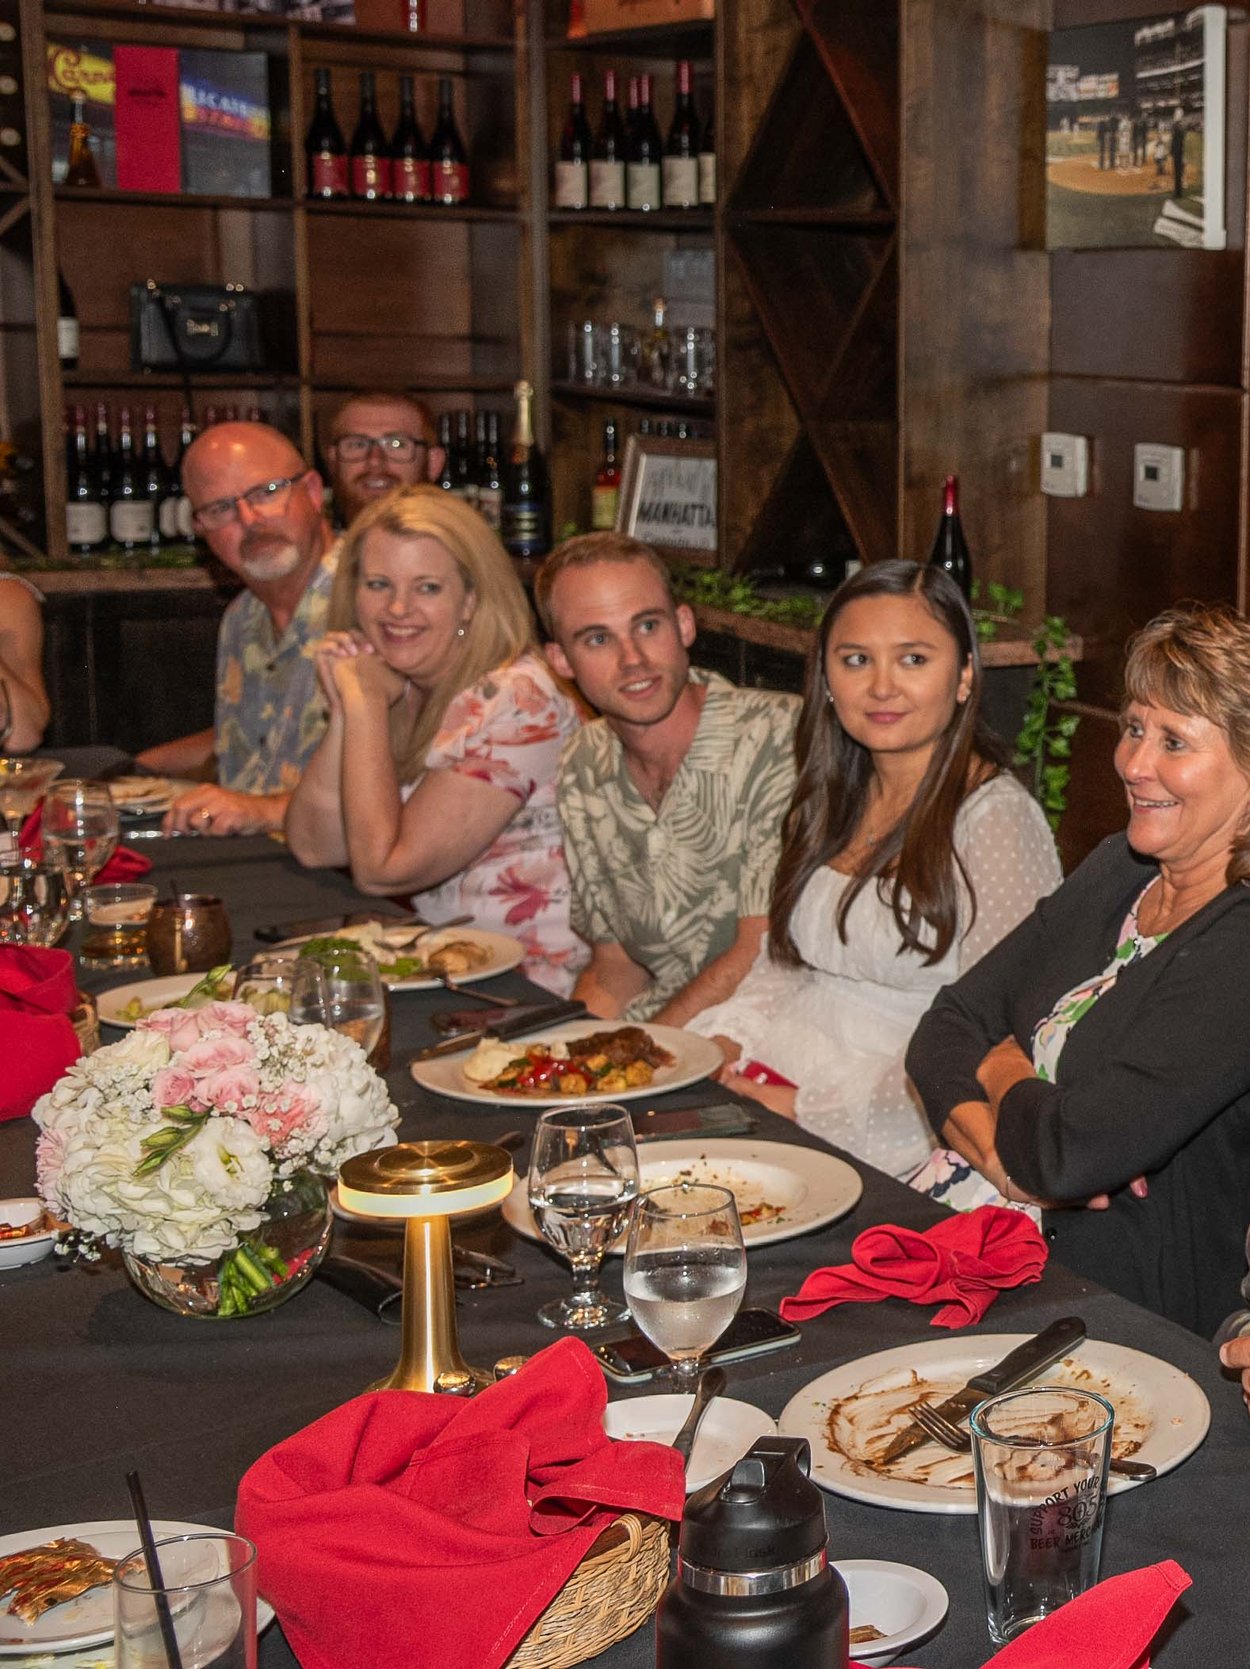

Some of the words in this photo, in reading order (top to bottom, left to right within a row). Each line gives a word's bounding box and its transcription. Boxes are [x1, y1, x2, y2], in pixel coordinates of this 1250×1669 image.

[1030, 1486, 1069, 1535] SUPPORT
[1073, 1475, 1100, 1495] YOUR
[1057, 1494, 1098, 1527] 805
[1030, 1536, 1061, 1550] BEER
